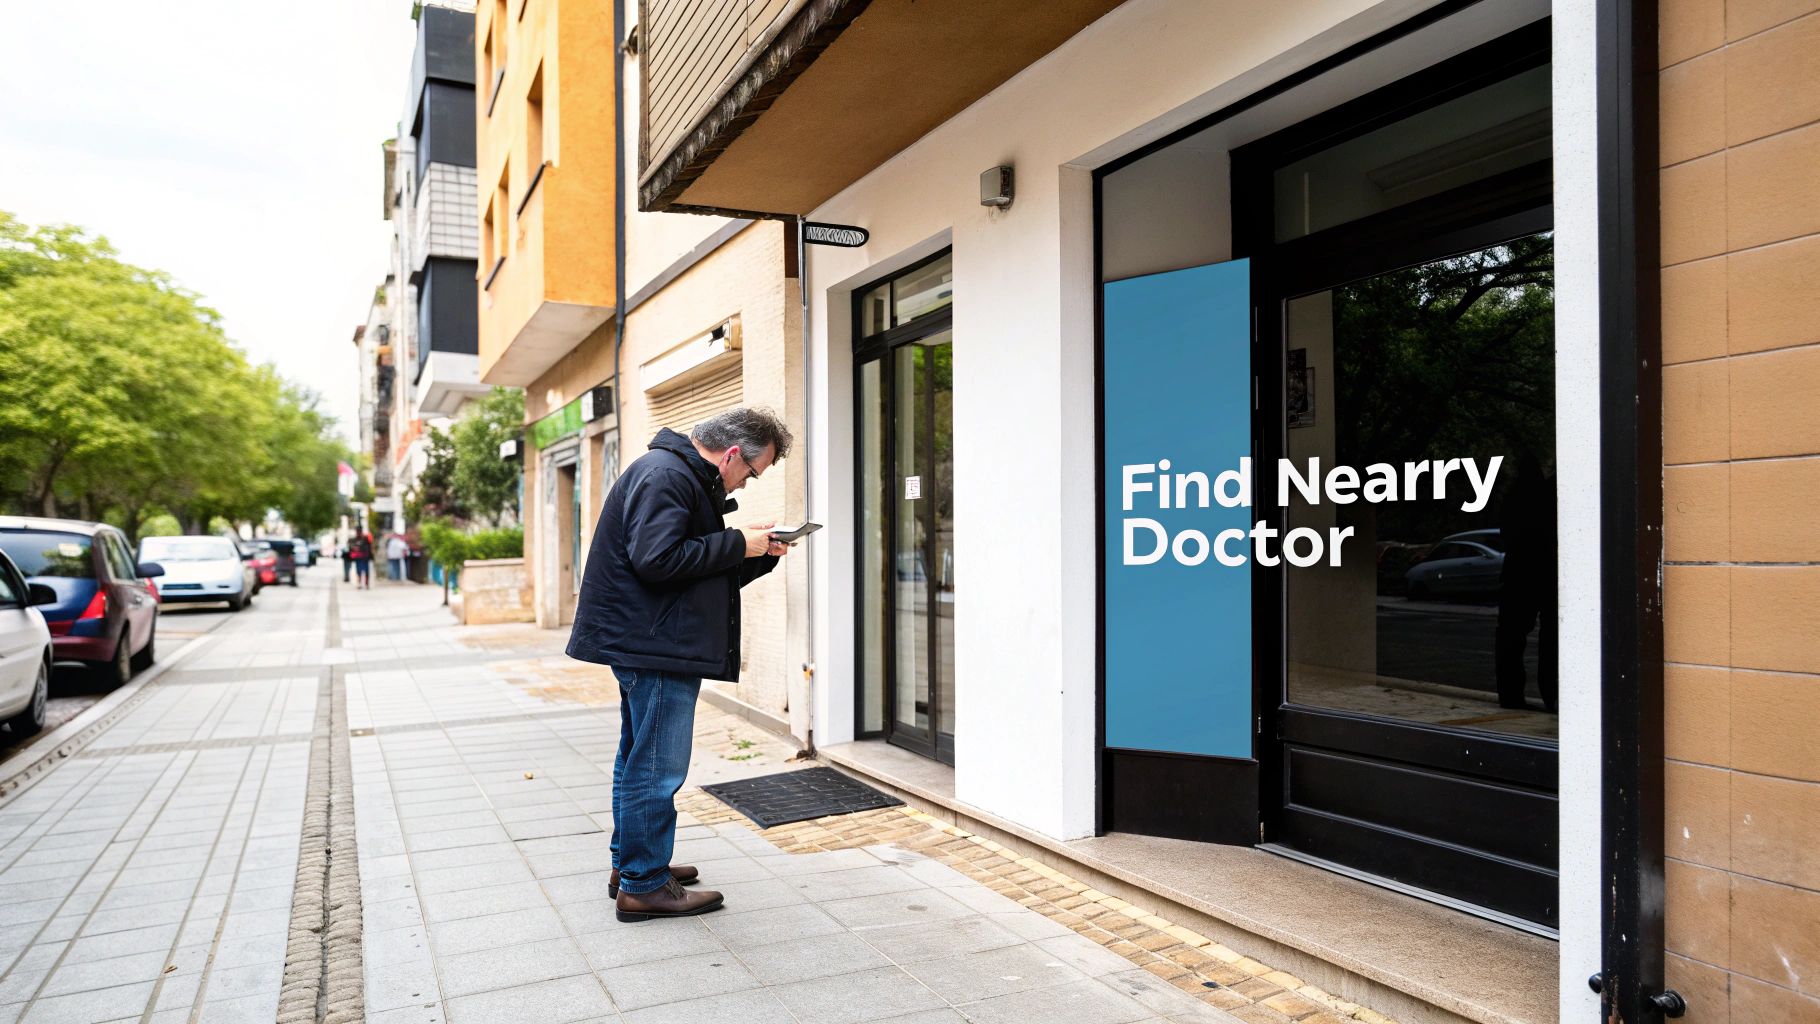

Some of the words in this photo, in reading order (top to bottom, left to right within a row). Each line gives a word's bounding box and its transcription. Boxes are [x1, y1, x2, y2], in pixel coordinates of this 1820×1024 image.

[1122, 456, 1252, 511] Find
[1278, 455, 1505, 513] Nearry
[1122, 517, 1355, 567] Doctor
